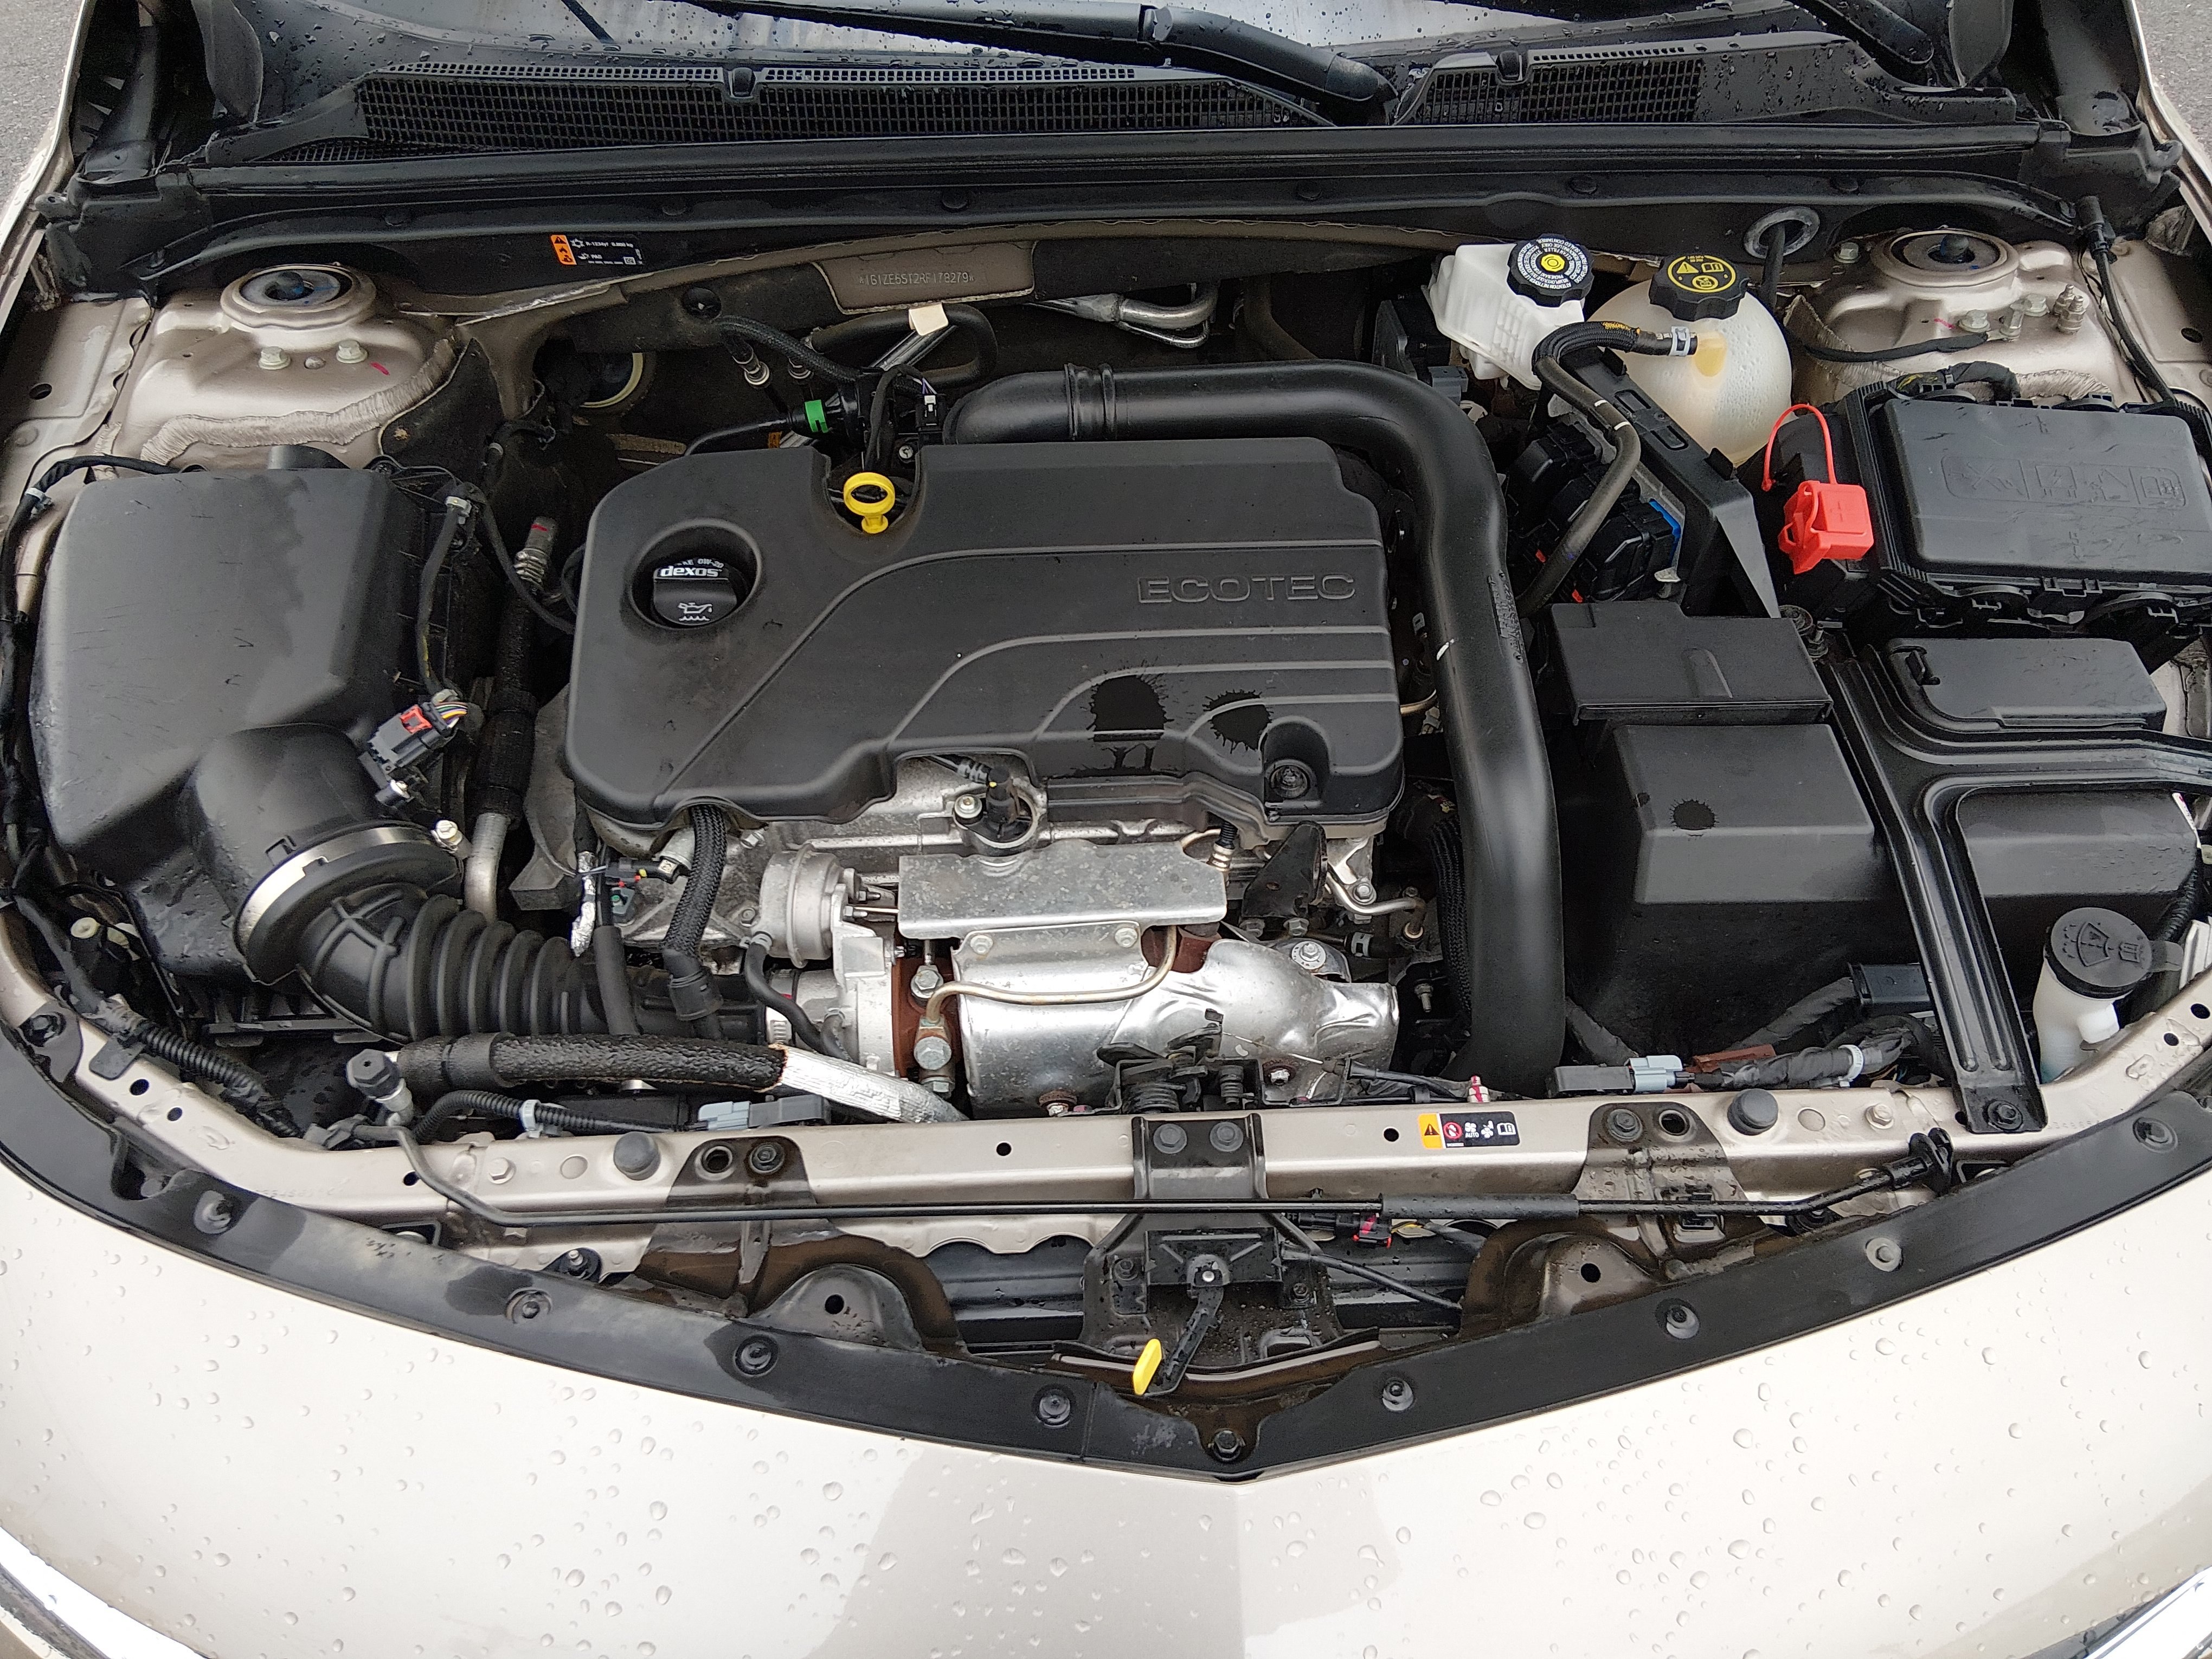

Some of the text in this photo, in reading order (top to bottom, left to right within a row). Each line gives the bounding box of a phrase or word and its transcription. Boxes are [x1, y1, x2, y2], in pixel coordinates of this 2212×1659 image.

[697, 558, 724, 569] 0W-20
[660, 565, 719, 577] dexos
[1137, 573, 1355, 603] ECOTEC
